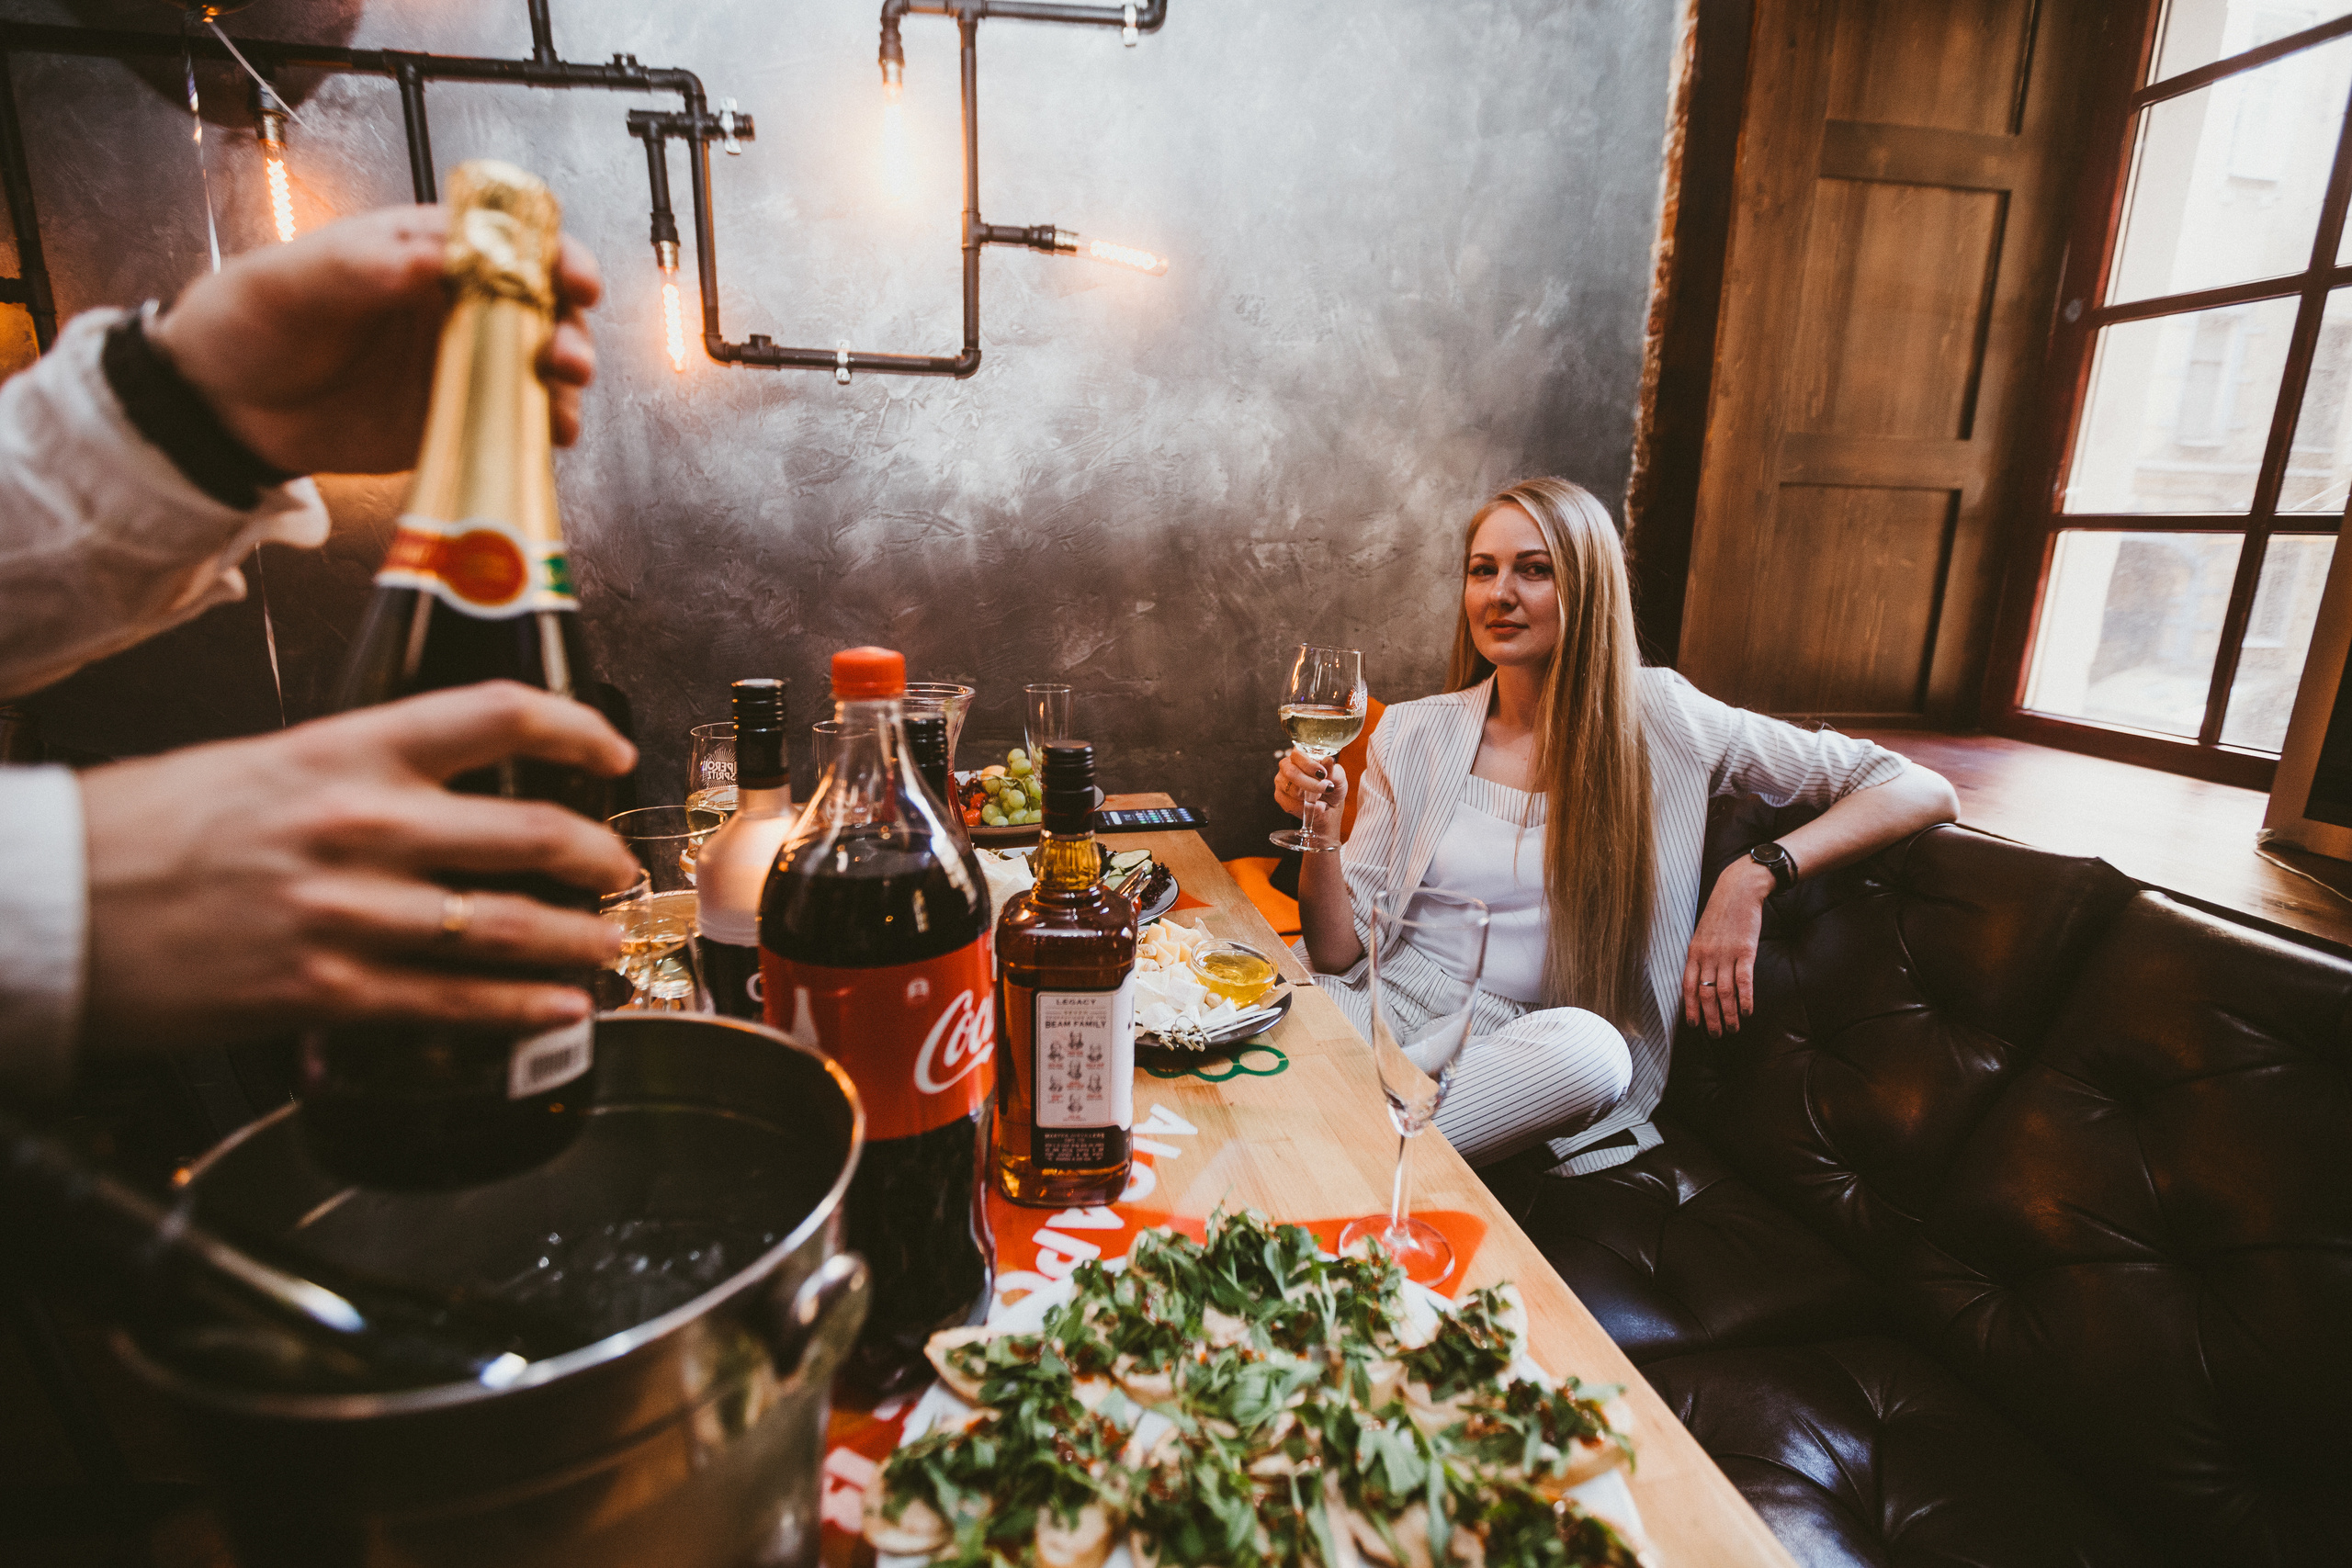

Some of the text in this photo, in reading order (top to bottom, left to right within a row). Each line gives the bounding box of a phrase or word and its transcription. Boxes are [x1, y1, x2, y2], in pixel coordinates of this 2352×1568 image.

[1056, 998, 1097, 1006] LEGACY
[1045, 1020, 1107, 1029] BEAM FAMILY
